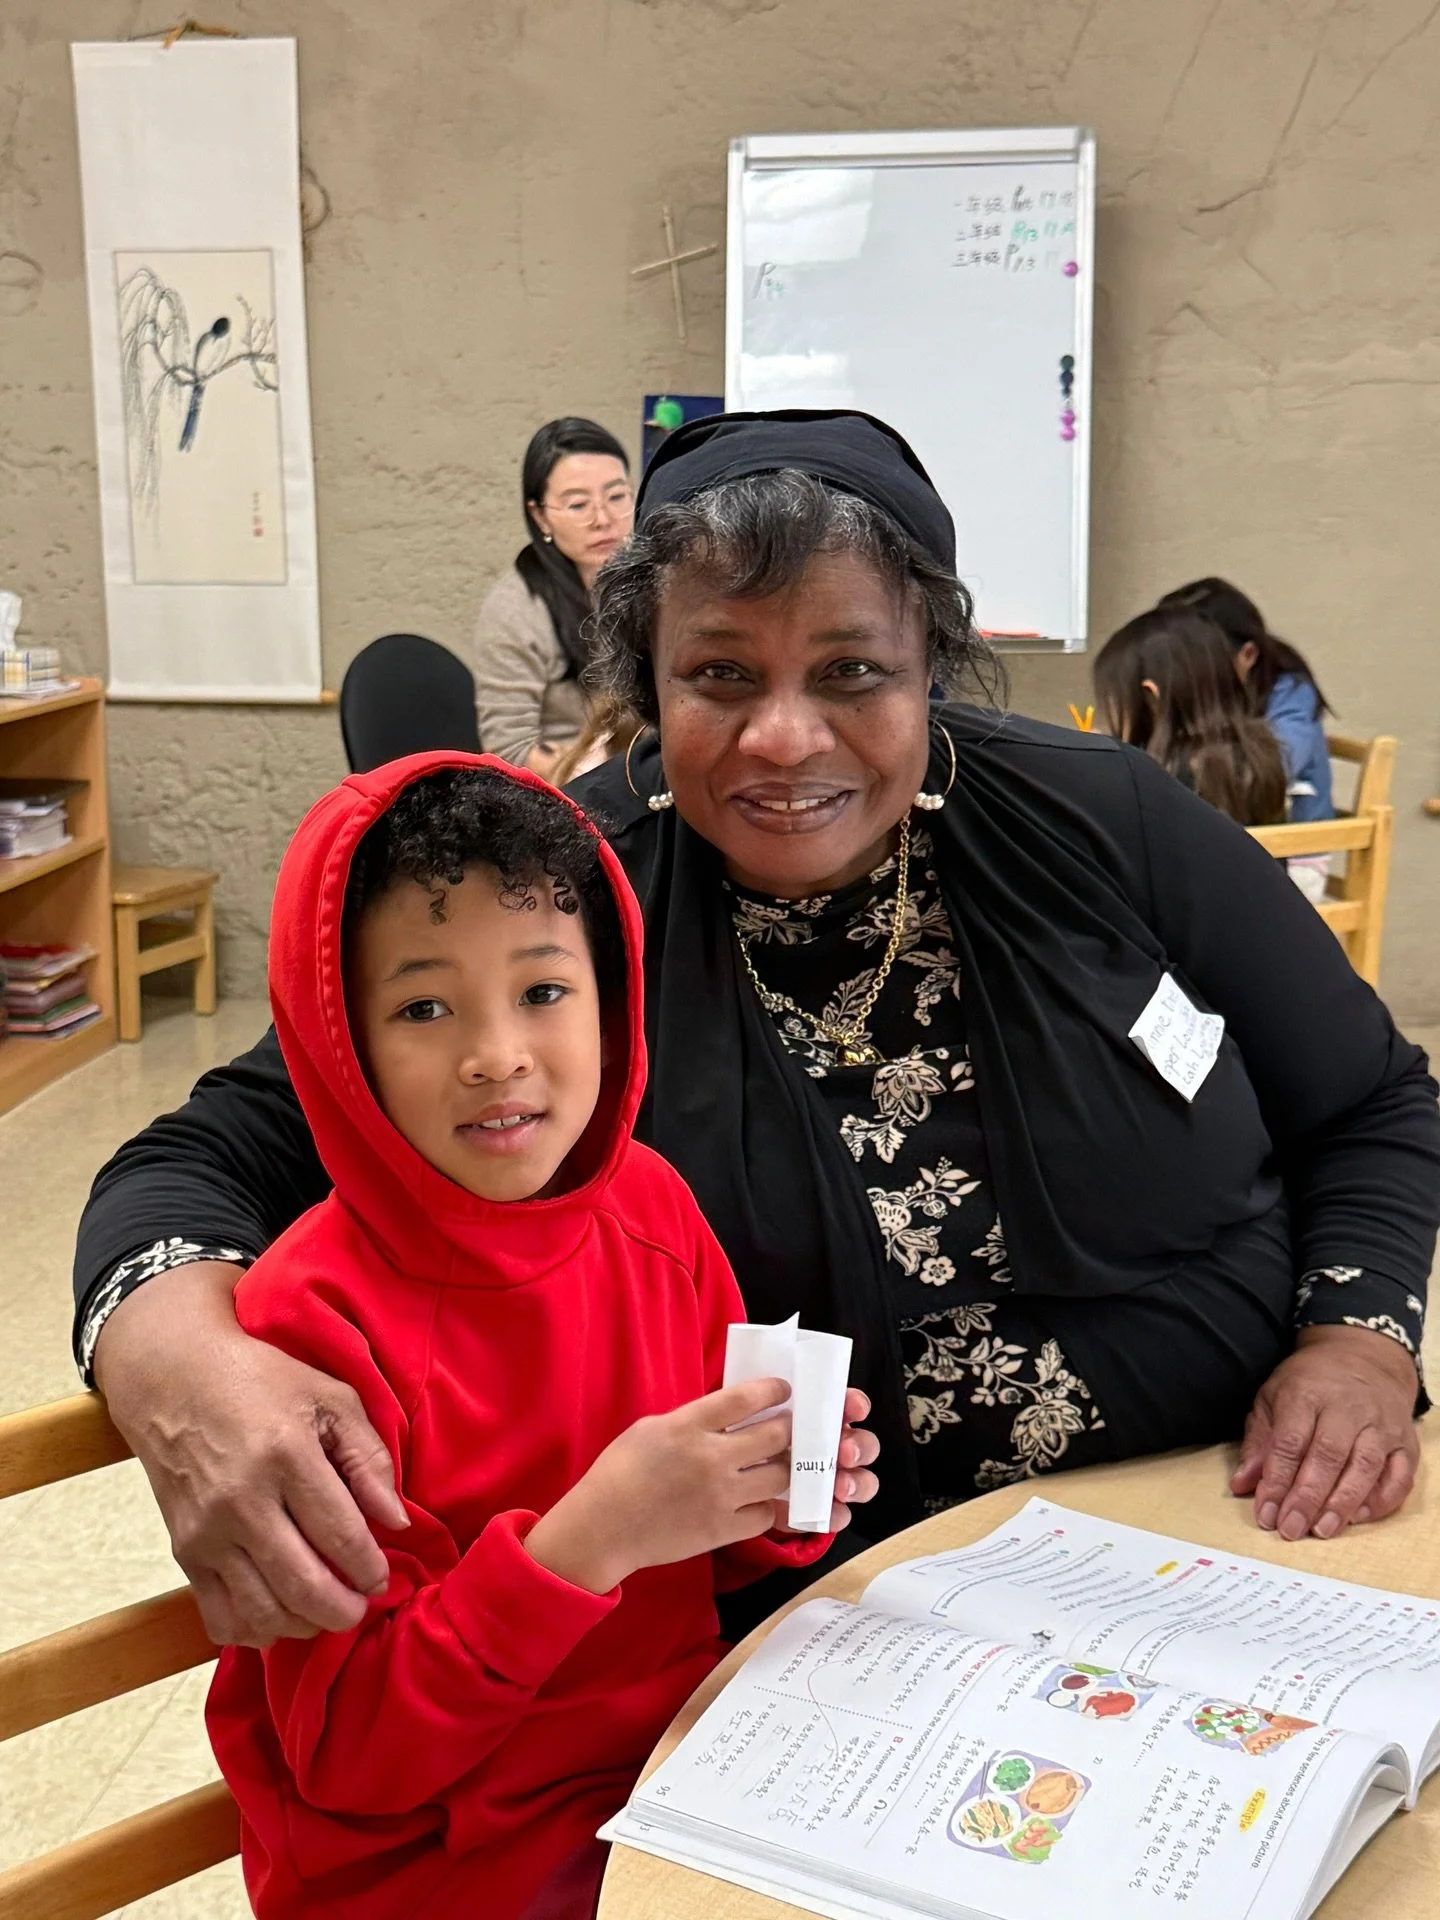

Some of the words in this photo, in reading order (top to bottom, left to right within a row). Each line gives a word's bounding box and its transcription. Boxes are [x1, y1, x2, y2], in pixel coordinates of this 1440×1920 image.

[795, 1459, 825, 1475] time
[970, 1659, 985, 1670] THE
[957, 1670, 975, 1687] TEXT
[941, 1687, 961, 1708] Listen
[928, 1714, 941, 1729] the
[936, 1707, 946, 1717] to
[905, 1726, 933, 1762] recording
[873, 1745, 896, 1772] Answer
[901, 1760, 912, 1771] of
[804, 1738, 876, 1832] 他们全家人上个周末去
[864, 1771, 878, 1785] the
[892, 1768, 907, 1785] Text
[1285, 1762, 1309, 1797] sentences
[655, 1785, 670, 1796] 95
[902, 1735, 987, 1858] 哥哥和他的三个朋友在一家
[838, 1784, 869, 1819] questions.
[1238, 1790, 1265, 1832] Example
[1273, 1797, 1289, 1820] about
[1265, 1819, 1278, 1840] each
[1172, 1802, 1232, 1901] 我和哥哥在一家快餐
